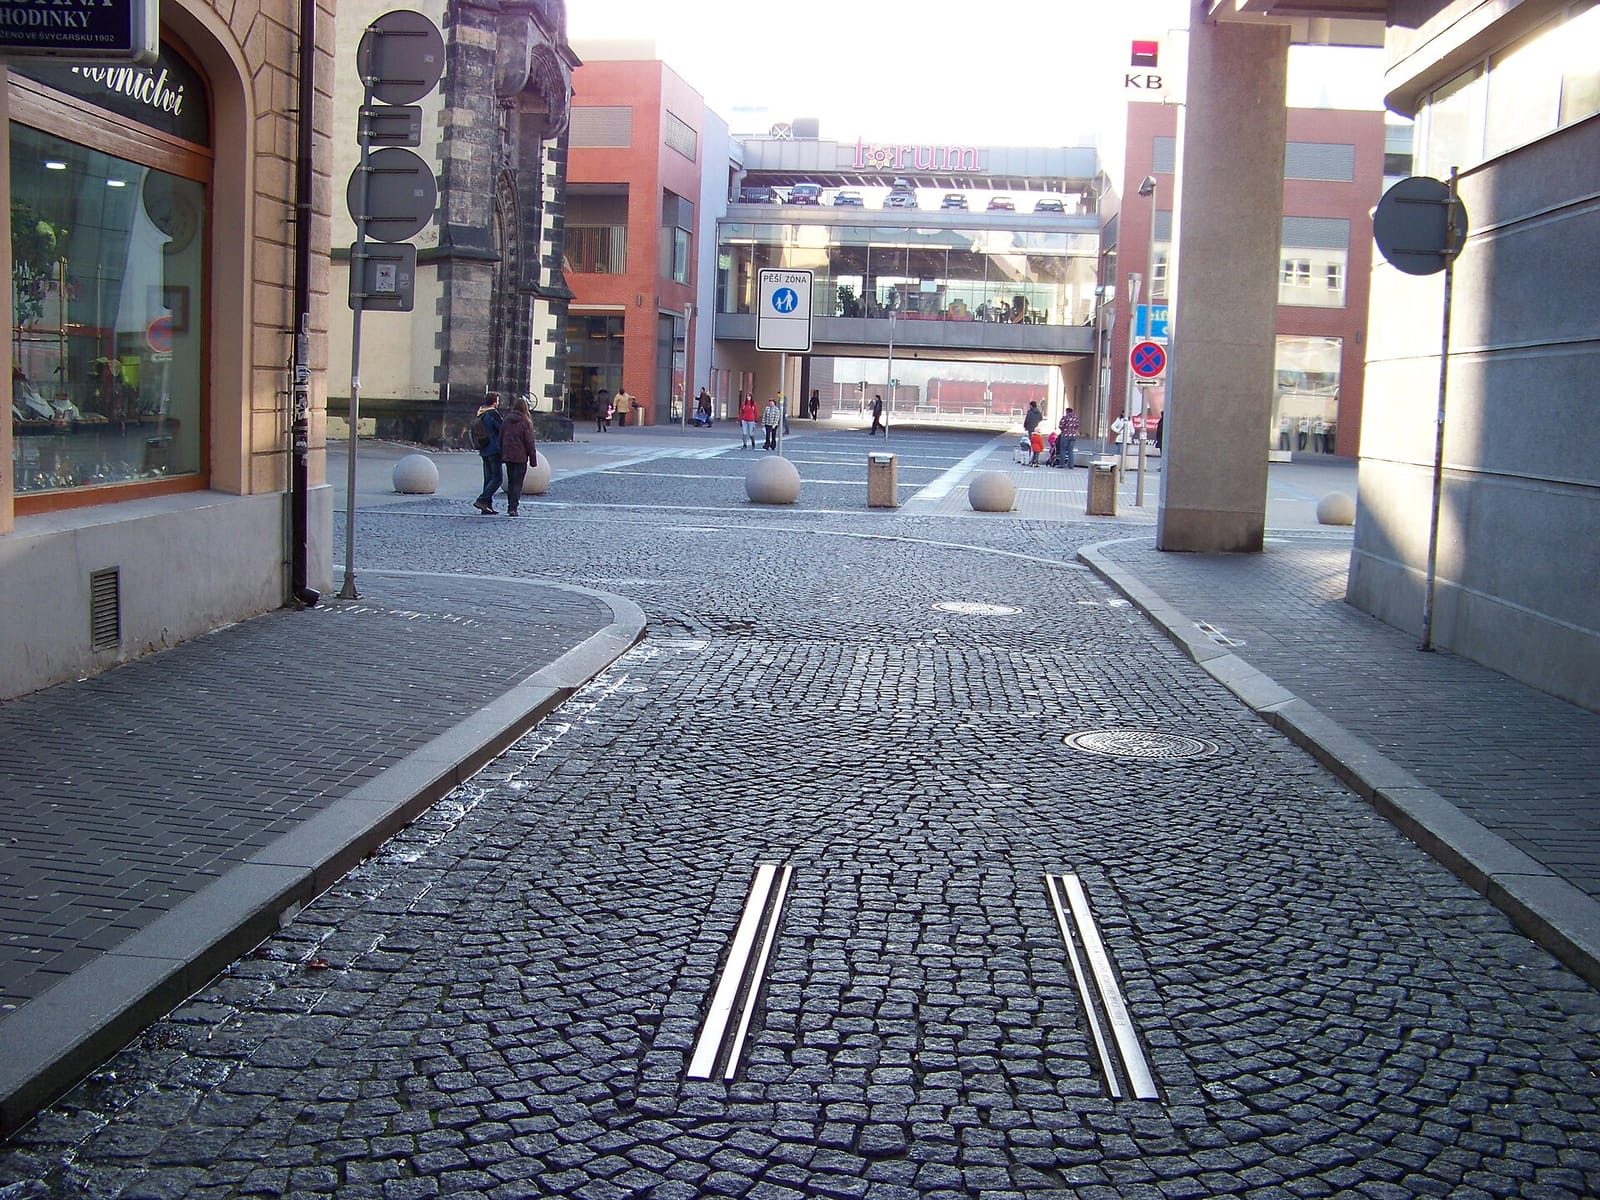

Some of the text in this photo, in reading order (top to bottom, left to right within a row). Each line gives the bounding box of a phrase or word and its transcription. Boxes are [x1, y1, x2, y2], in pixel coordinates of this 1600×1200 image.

[0, 8, 91, 28] HODINKY
[95, 34, 115, 42] 1902
[1125, 74, 1163, 90] KB
[763, 273, 808, 284] PĚŠÍ ZÓNA
